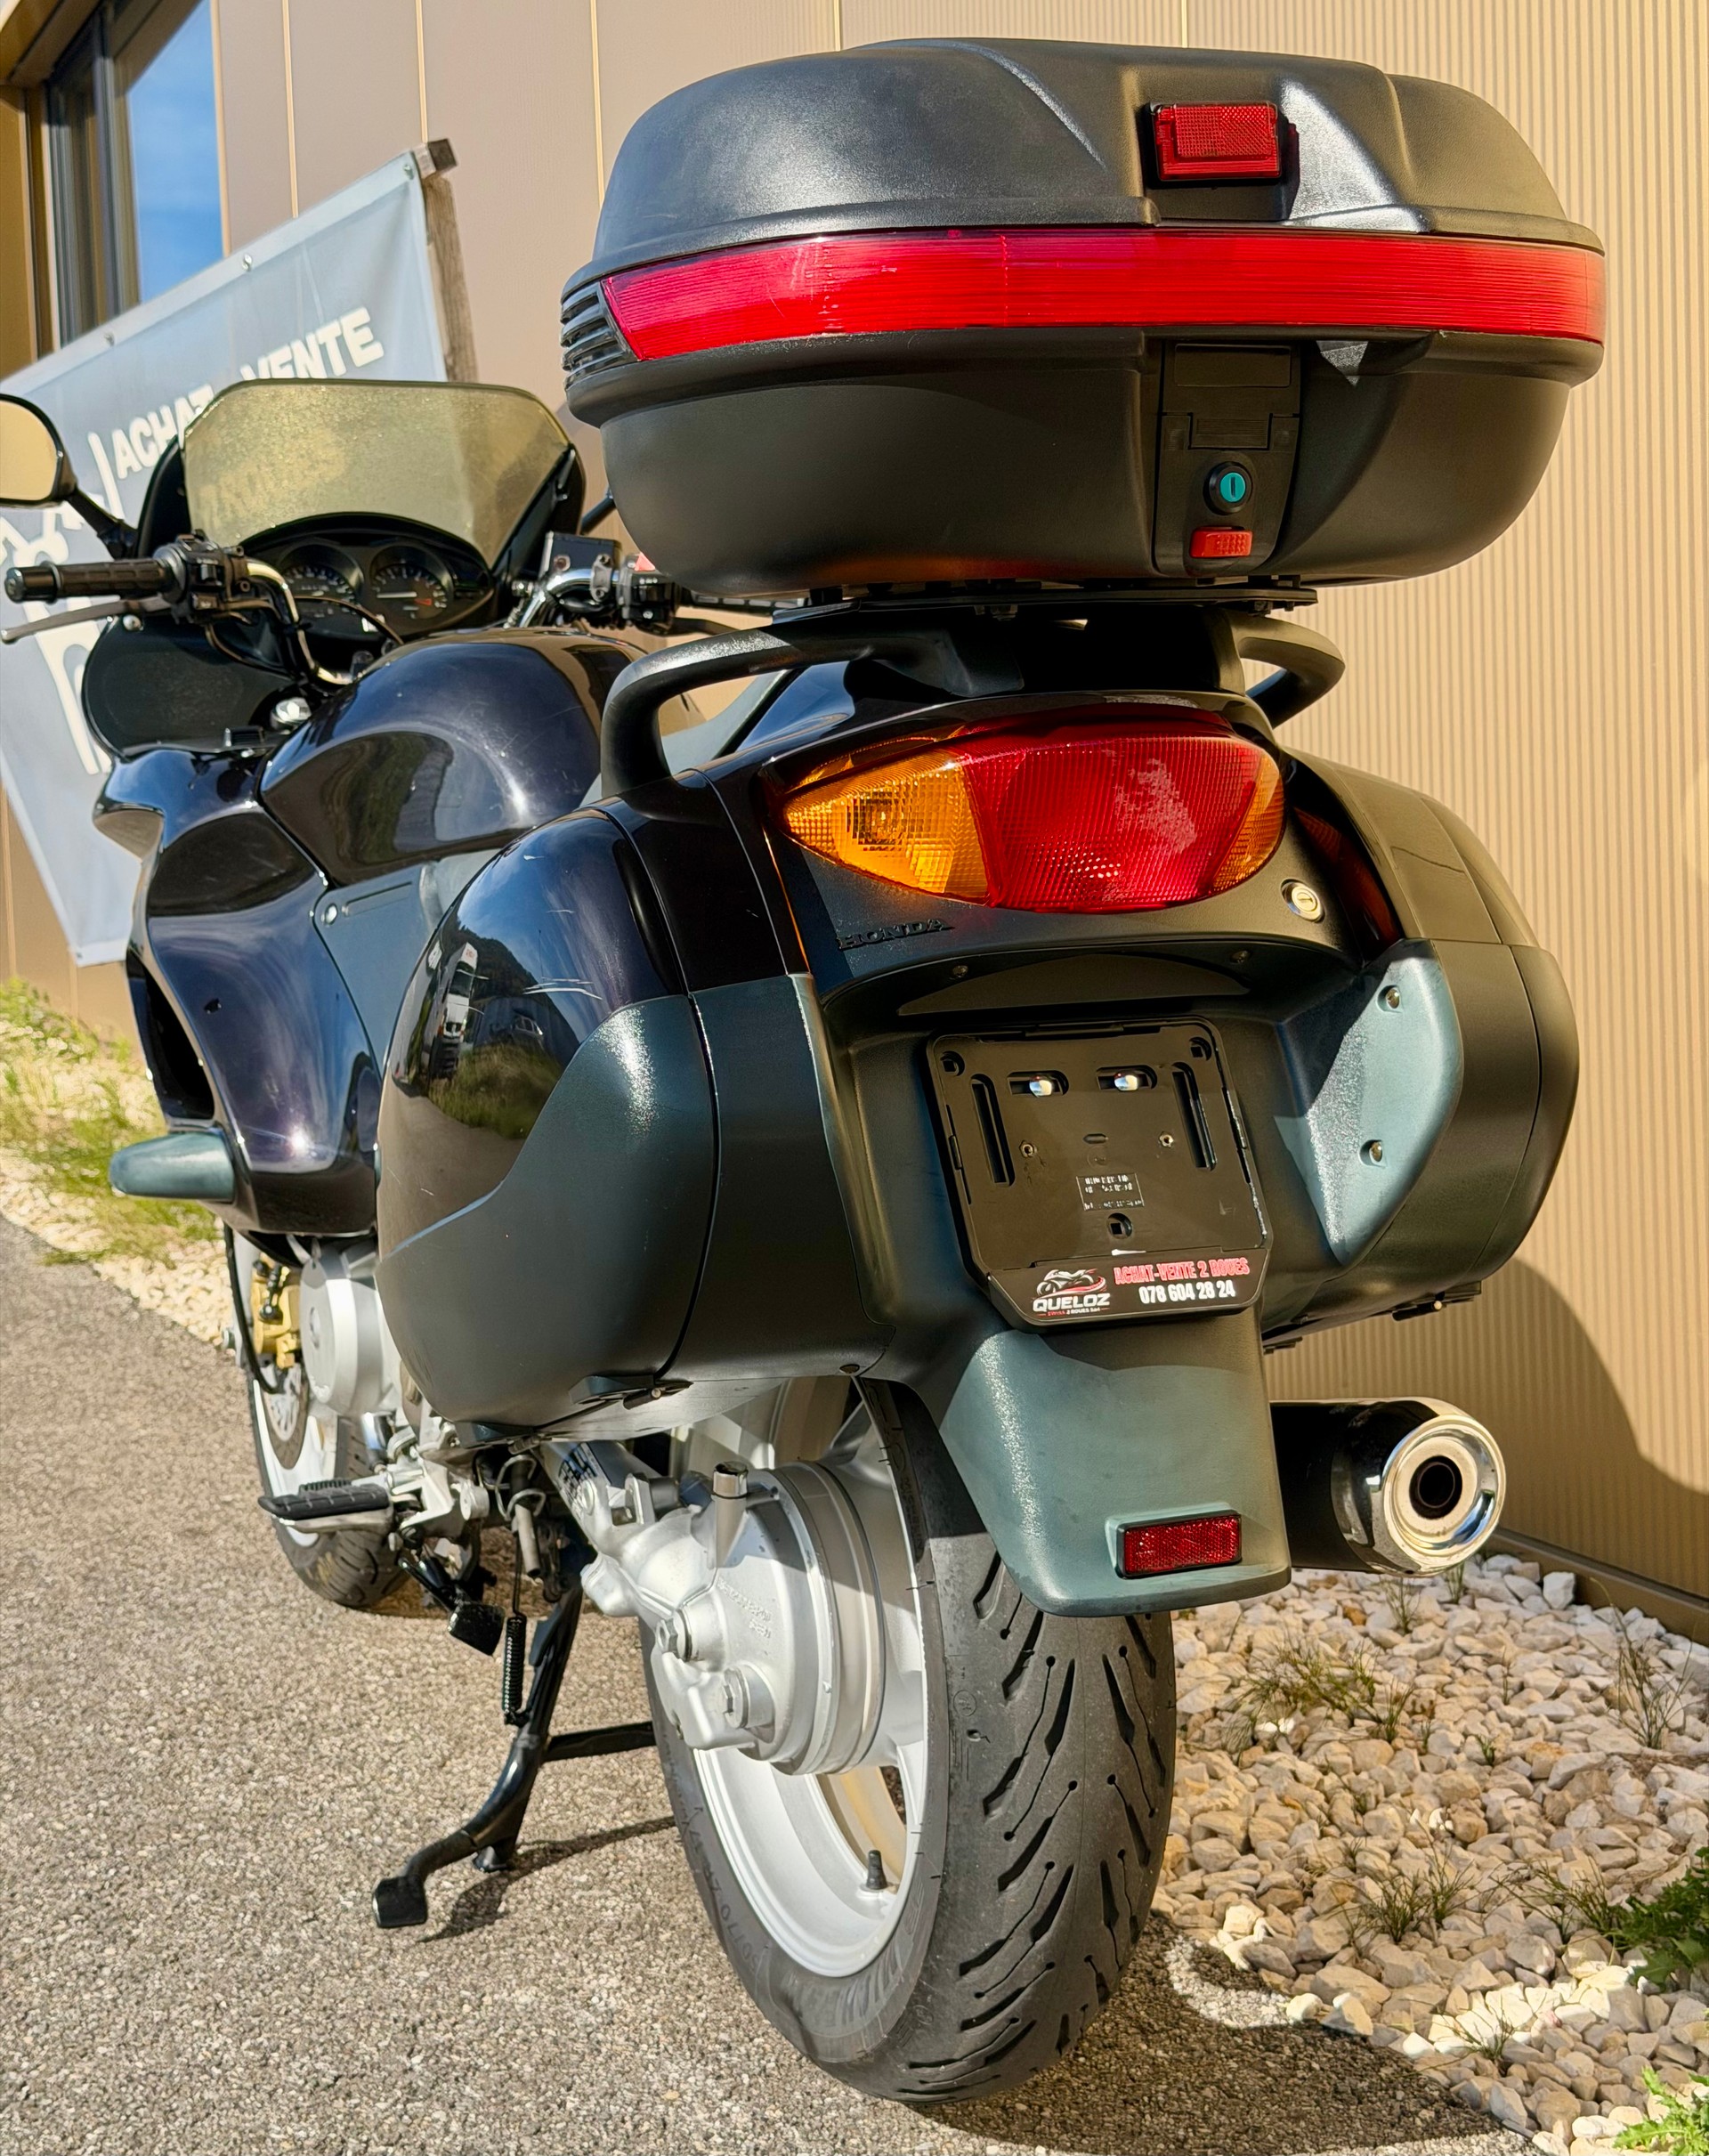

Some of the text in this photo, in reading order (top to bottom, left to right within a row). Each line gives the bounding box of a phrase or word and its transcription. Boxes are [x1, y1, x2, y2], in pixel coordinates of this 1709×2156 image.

[836, 919, 950, 950] HONDA
[1114, 1257, 1251, 1285] ACHAT-VENTE 2 ROUES
[1033, 1293, 1111, 1312] QUELOZ
[1138, 1279, 1236, 1304] 078 604 28 24
